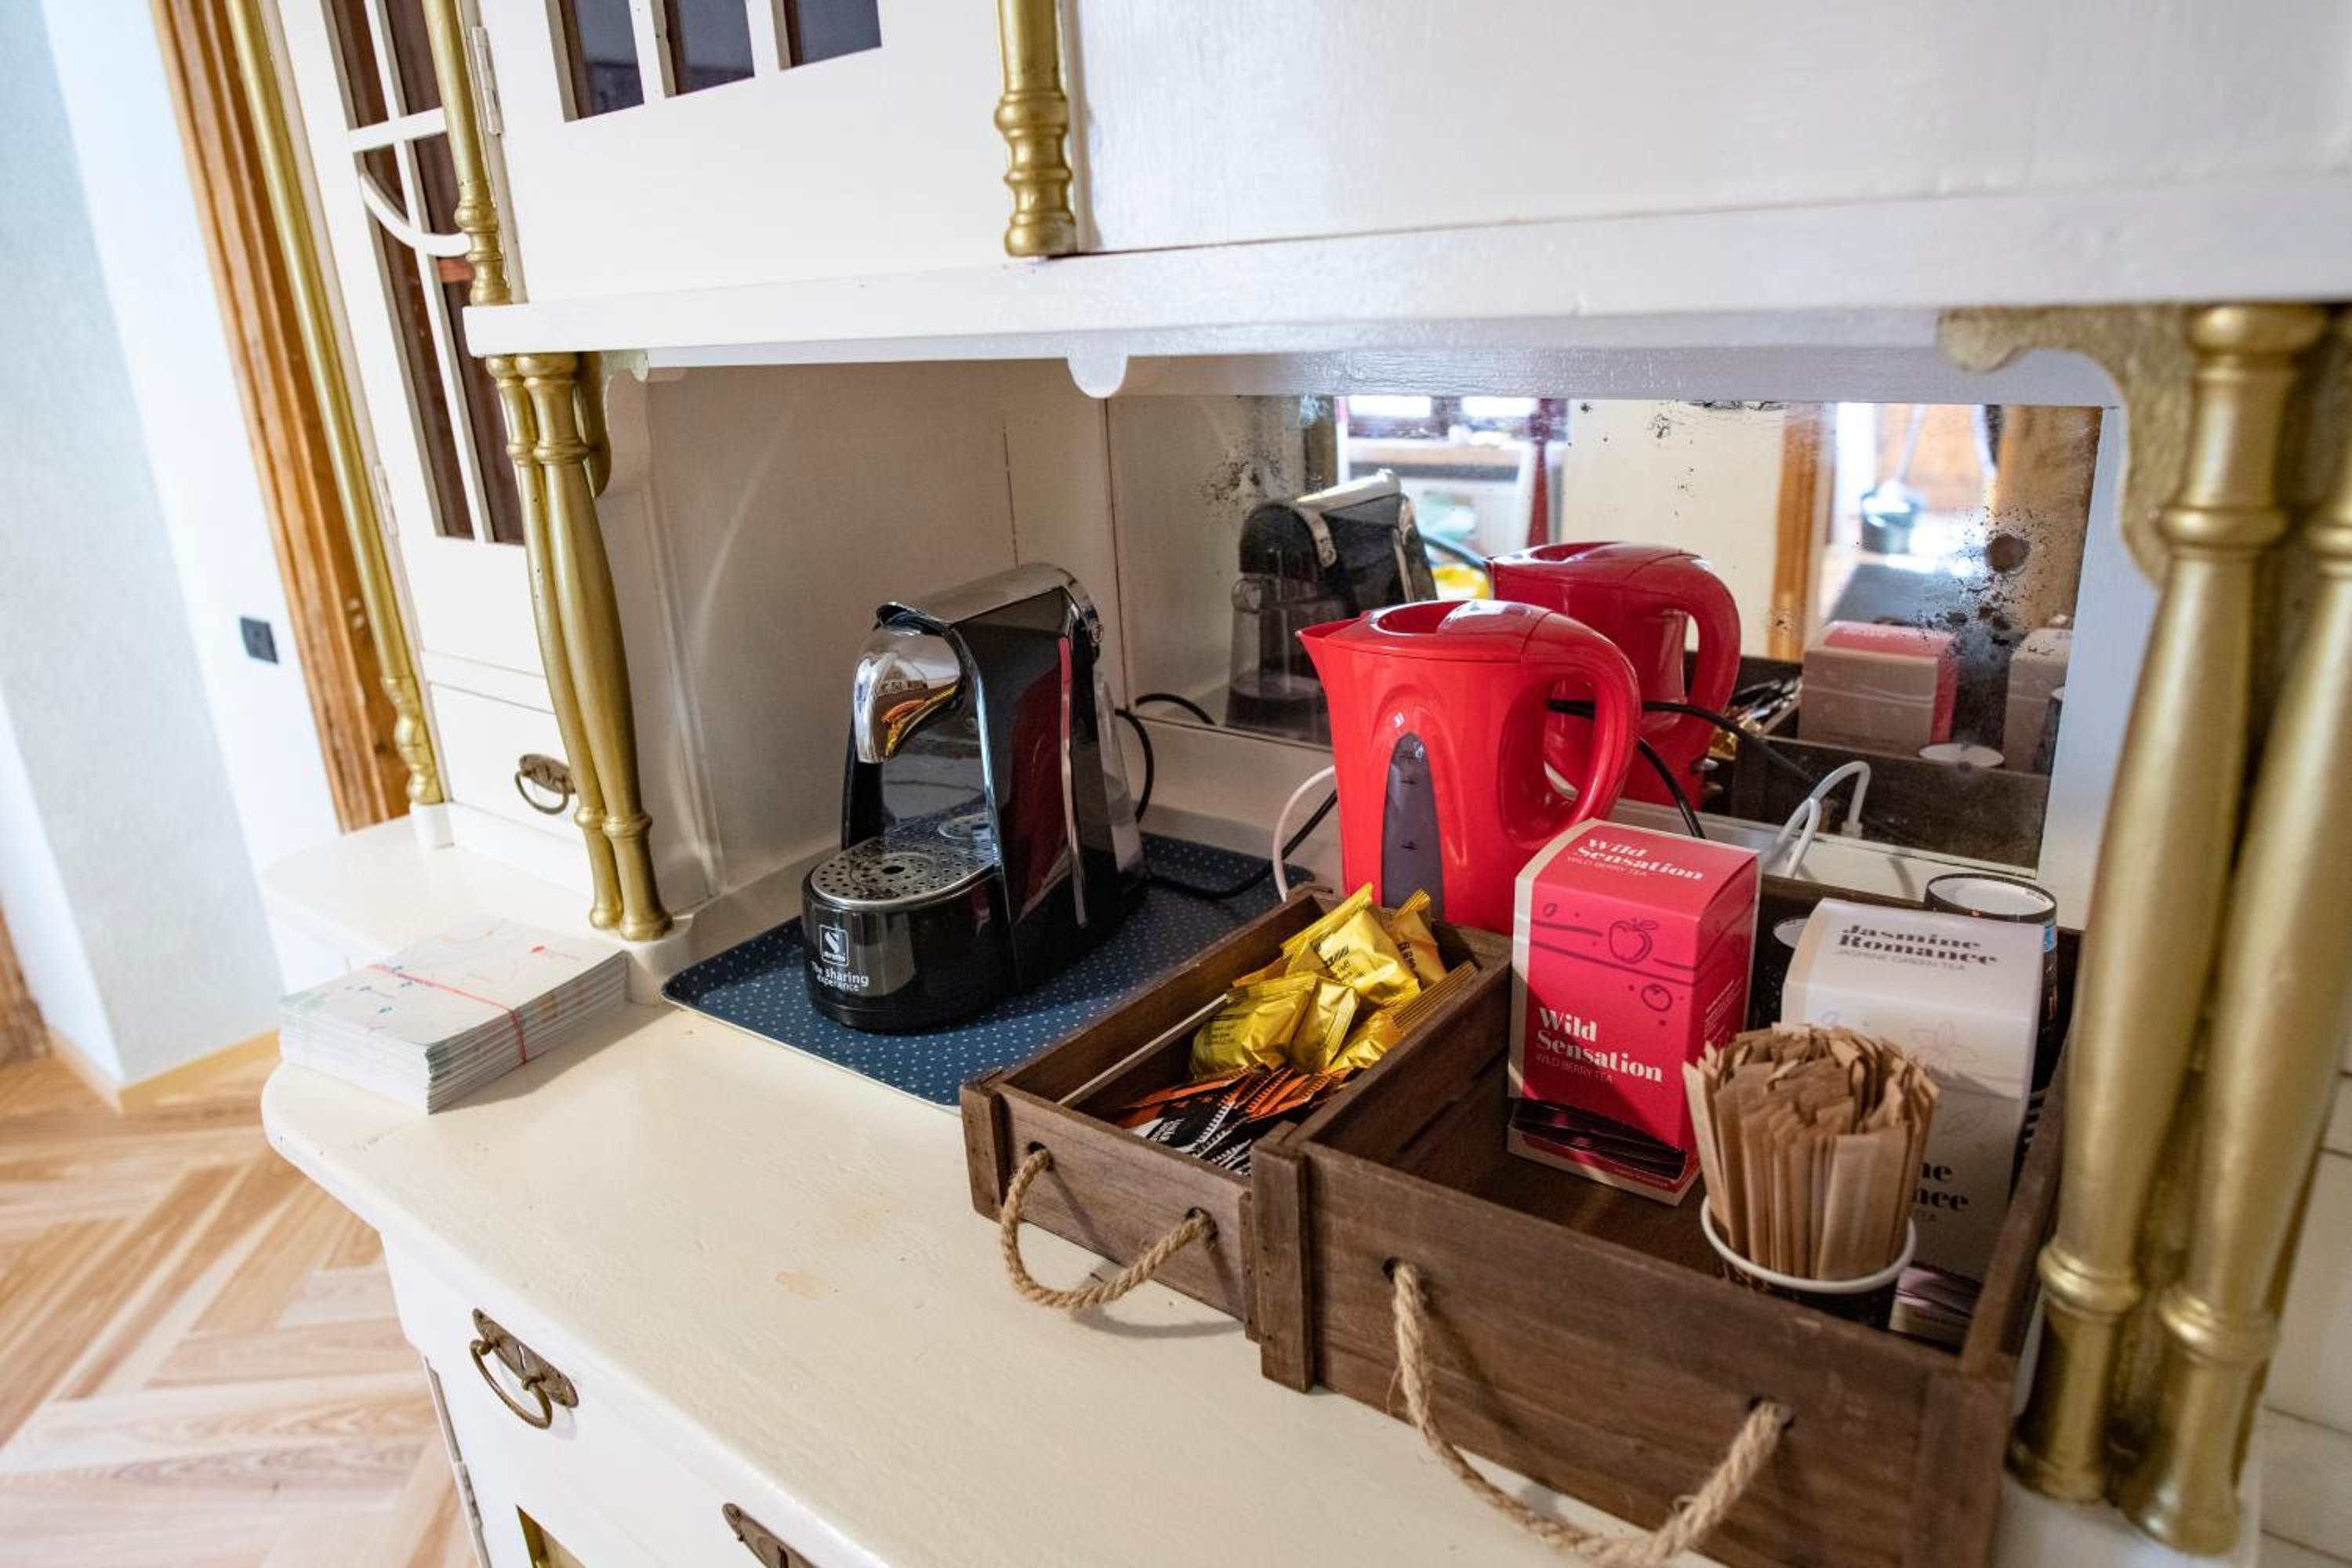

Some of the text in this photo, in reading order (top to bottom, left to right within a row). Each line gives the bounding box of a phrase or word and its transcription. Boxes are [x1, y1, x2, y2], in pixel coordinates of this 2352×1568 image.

[1577, 846, 1704, 880] Sensation
[1588, 838, 1648, 857] Wild
[1839, 934, 1998, 965] Romance
[1842, 924, 1981, 949] Jasmine
[825, 967, 869, 987] sharing
[1941, 960, 1966, 971] TEA
[1539, 1007, 1597, 1042] Wild
[1536, 1053, 1613, 1084] WILD BERRY TEA
[1537, 1029, 1664, 1083] Sensation
